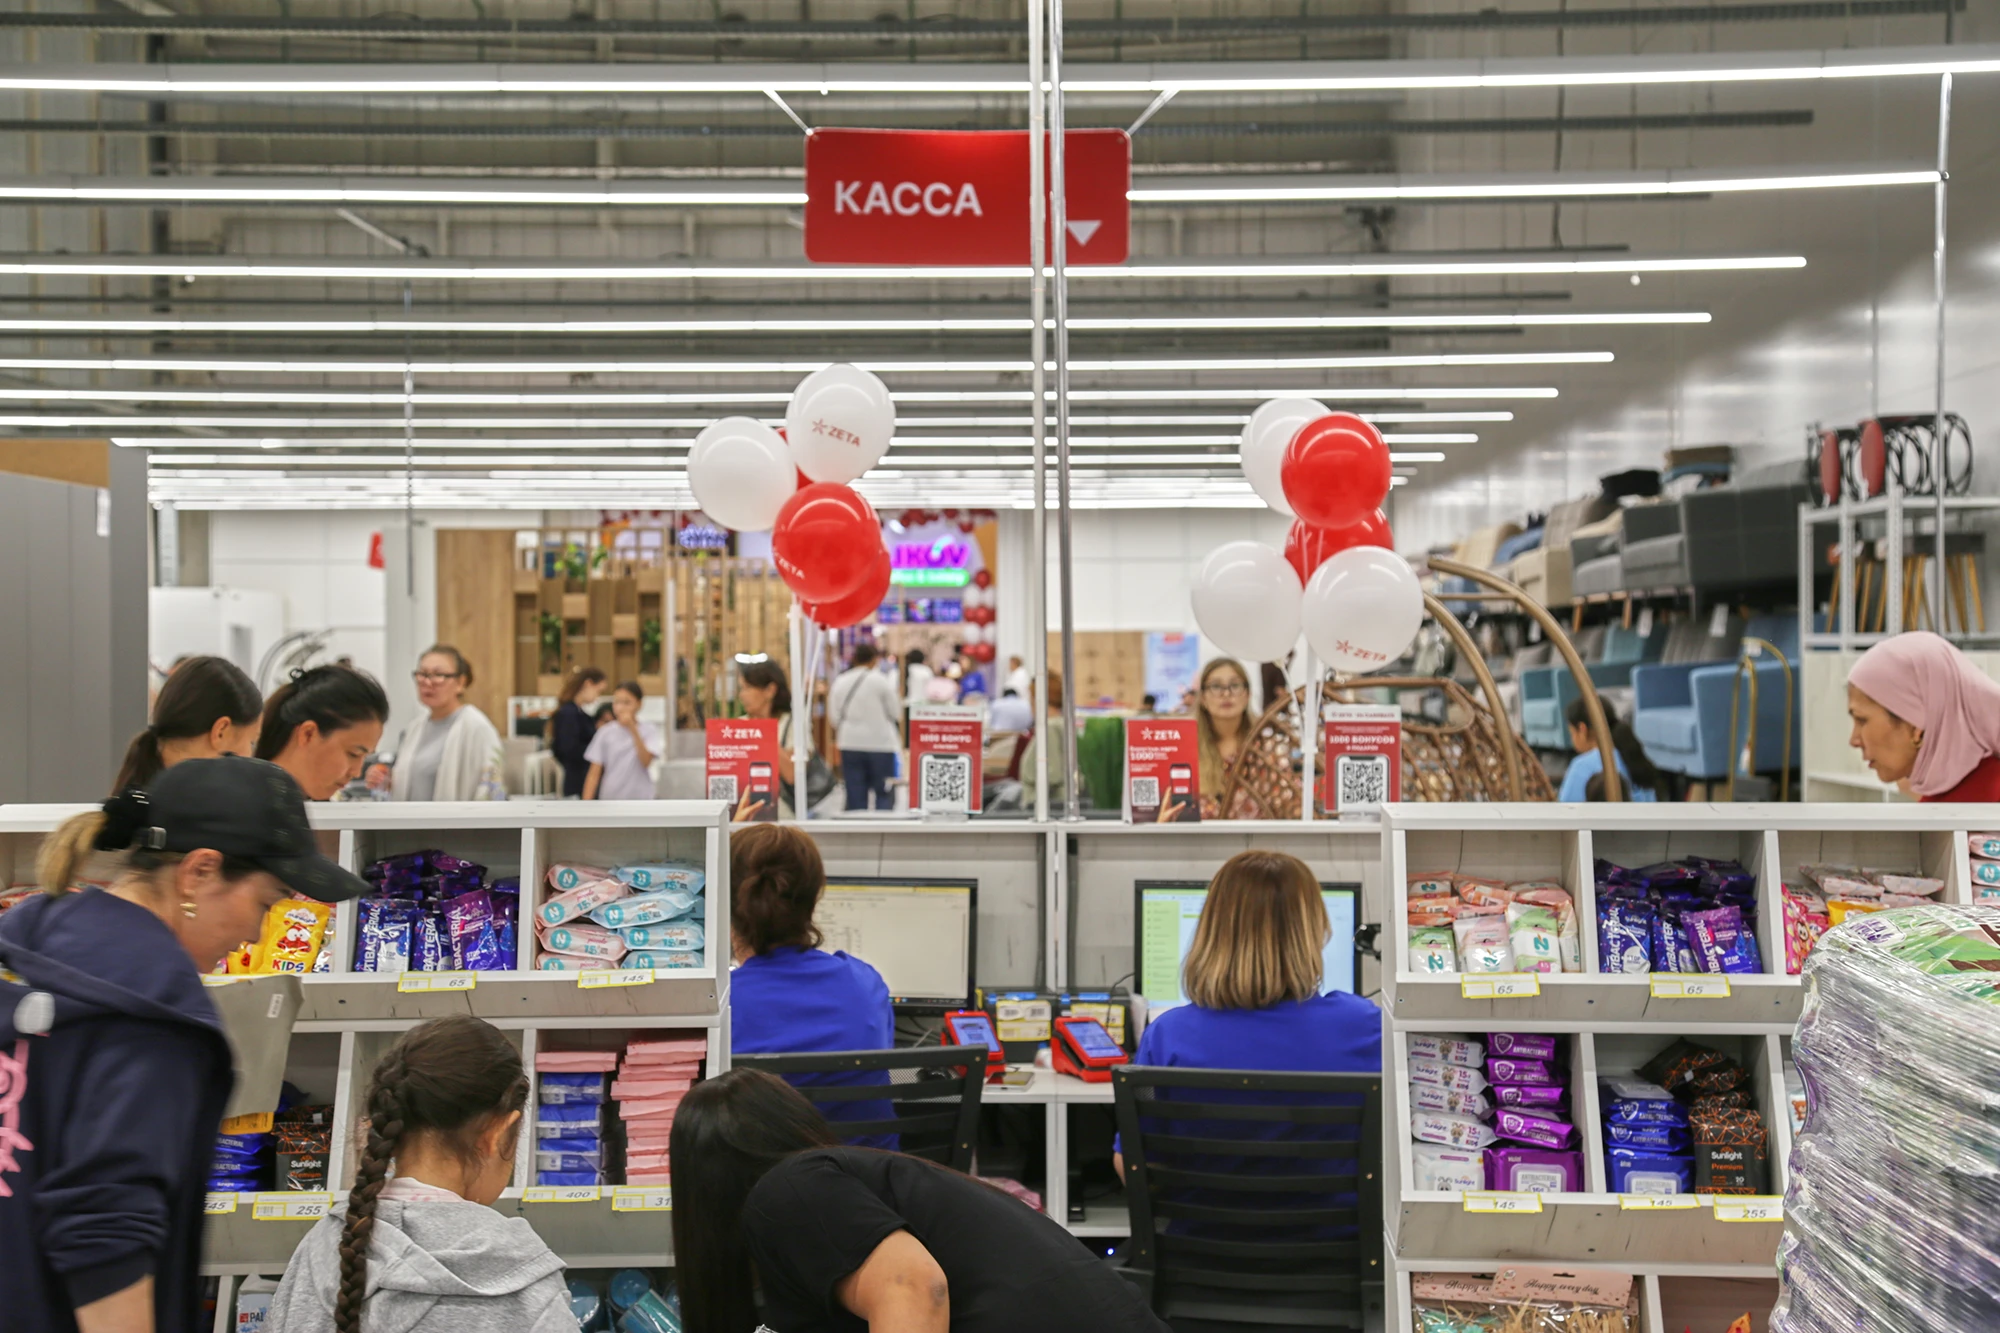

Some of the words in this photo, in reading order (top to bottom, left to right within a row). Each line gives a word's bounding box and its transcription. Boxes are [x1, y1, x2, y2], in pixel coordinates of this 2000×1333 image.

[835, 181, 983, 216] КАССА
[828, 425, 860, 447] ZETA
[778, 558, 806, 580] ZETA
[1353, 647, 1387, 661] ZETA
[734, 728, 763, 739] ZETA
[1154, 730, 1181, 740] ZETA
[272, 959, 305, 972] KIDS
[449, 979, 466, 987] 65
[1497, 985, 1513, 994] 65
[1687, 985, 1703, 994] 65
[1711, 1151, 1743, 1161] Sunlight
[290, 1160, 322, 1169] Sunlight
[206, 1201, 226, 1210] 45
[655, 1198, 672, 1206] 31
[1494, 1201, 1515, 1209] 145
[1651, 1199, 1672, 1207] 145
[296, 1205, 322, 1215] 255
[1741, 1209, 1767, 1218] 255
[1445, 1280, 1479, 1292] Happy
[1524, 1279, 1557, 1292] Happy
[1559, 1283, 1582, 1294] every
[1582, 1287, 1600, 1295] day
